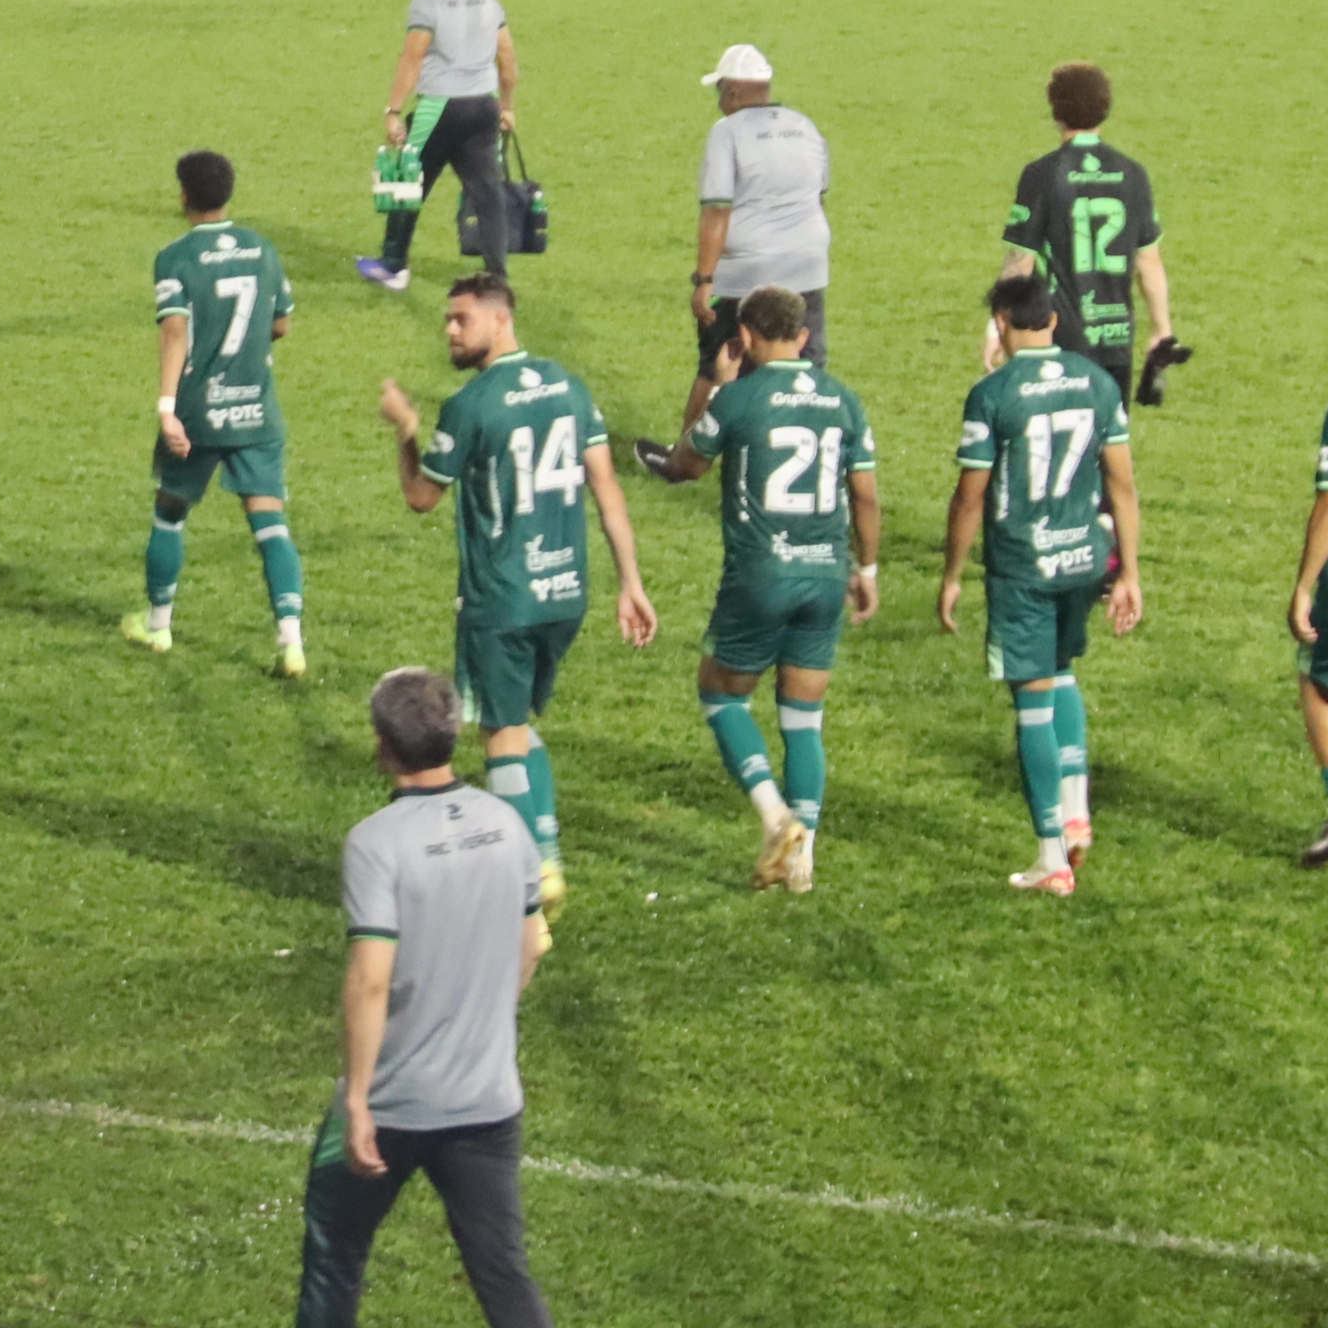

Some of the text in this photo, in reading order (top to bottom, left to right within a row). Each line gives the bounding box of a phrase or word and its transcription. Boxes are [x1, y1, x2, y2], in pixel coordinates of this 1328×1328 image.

[1072, 196, 1128, 273] 12
[215, 275, 258, 357] 7
[229, 403, 264, 422] DTC
[509, 415, 585, 514] 14
[764, 425, 843, 514] 21
[1025, 408, 1095, 502] 17
[1061, 545, 1094, 568] DTC
